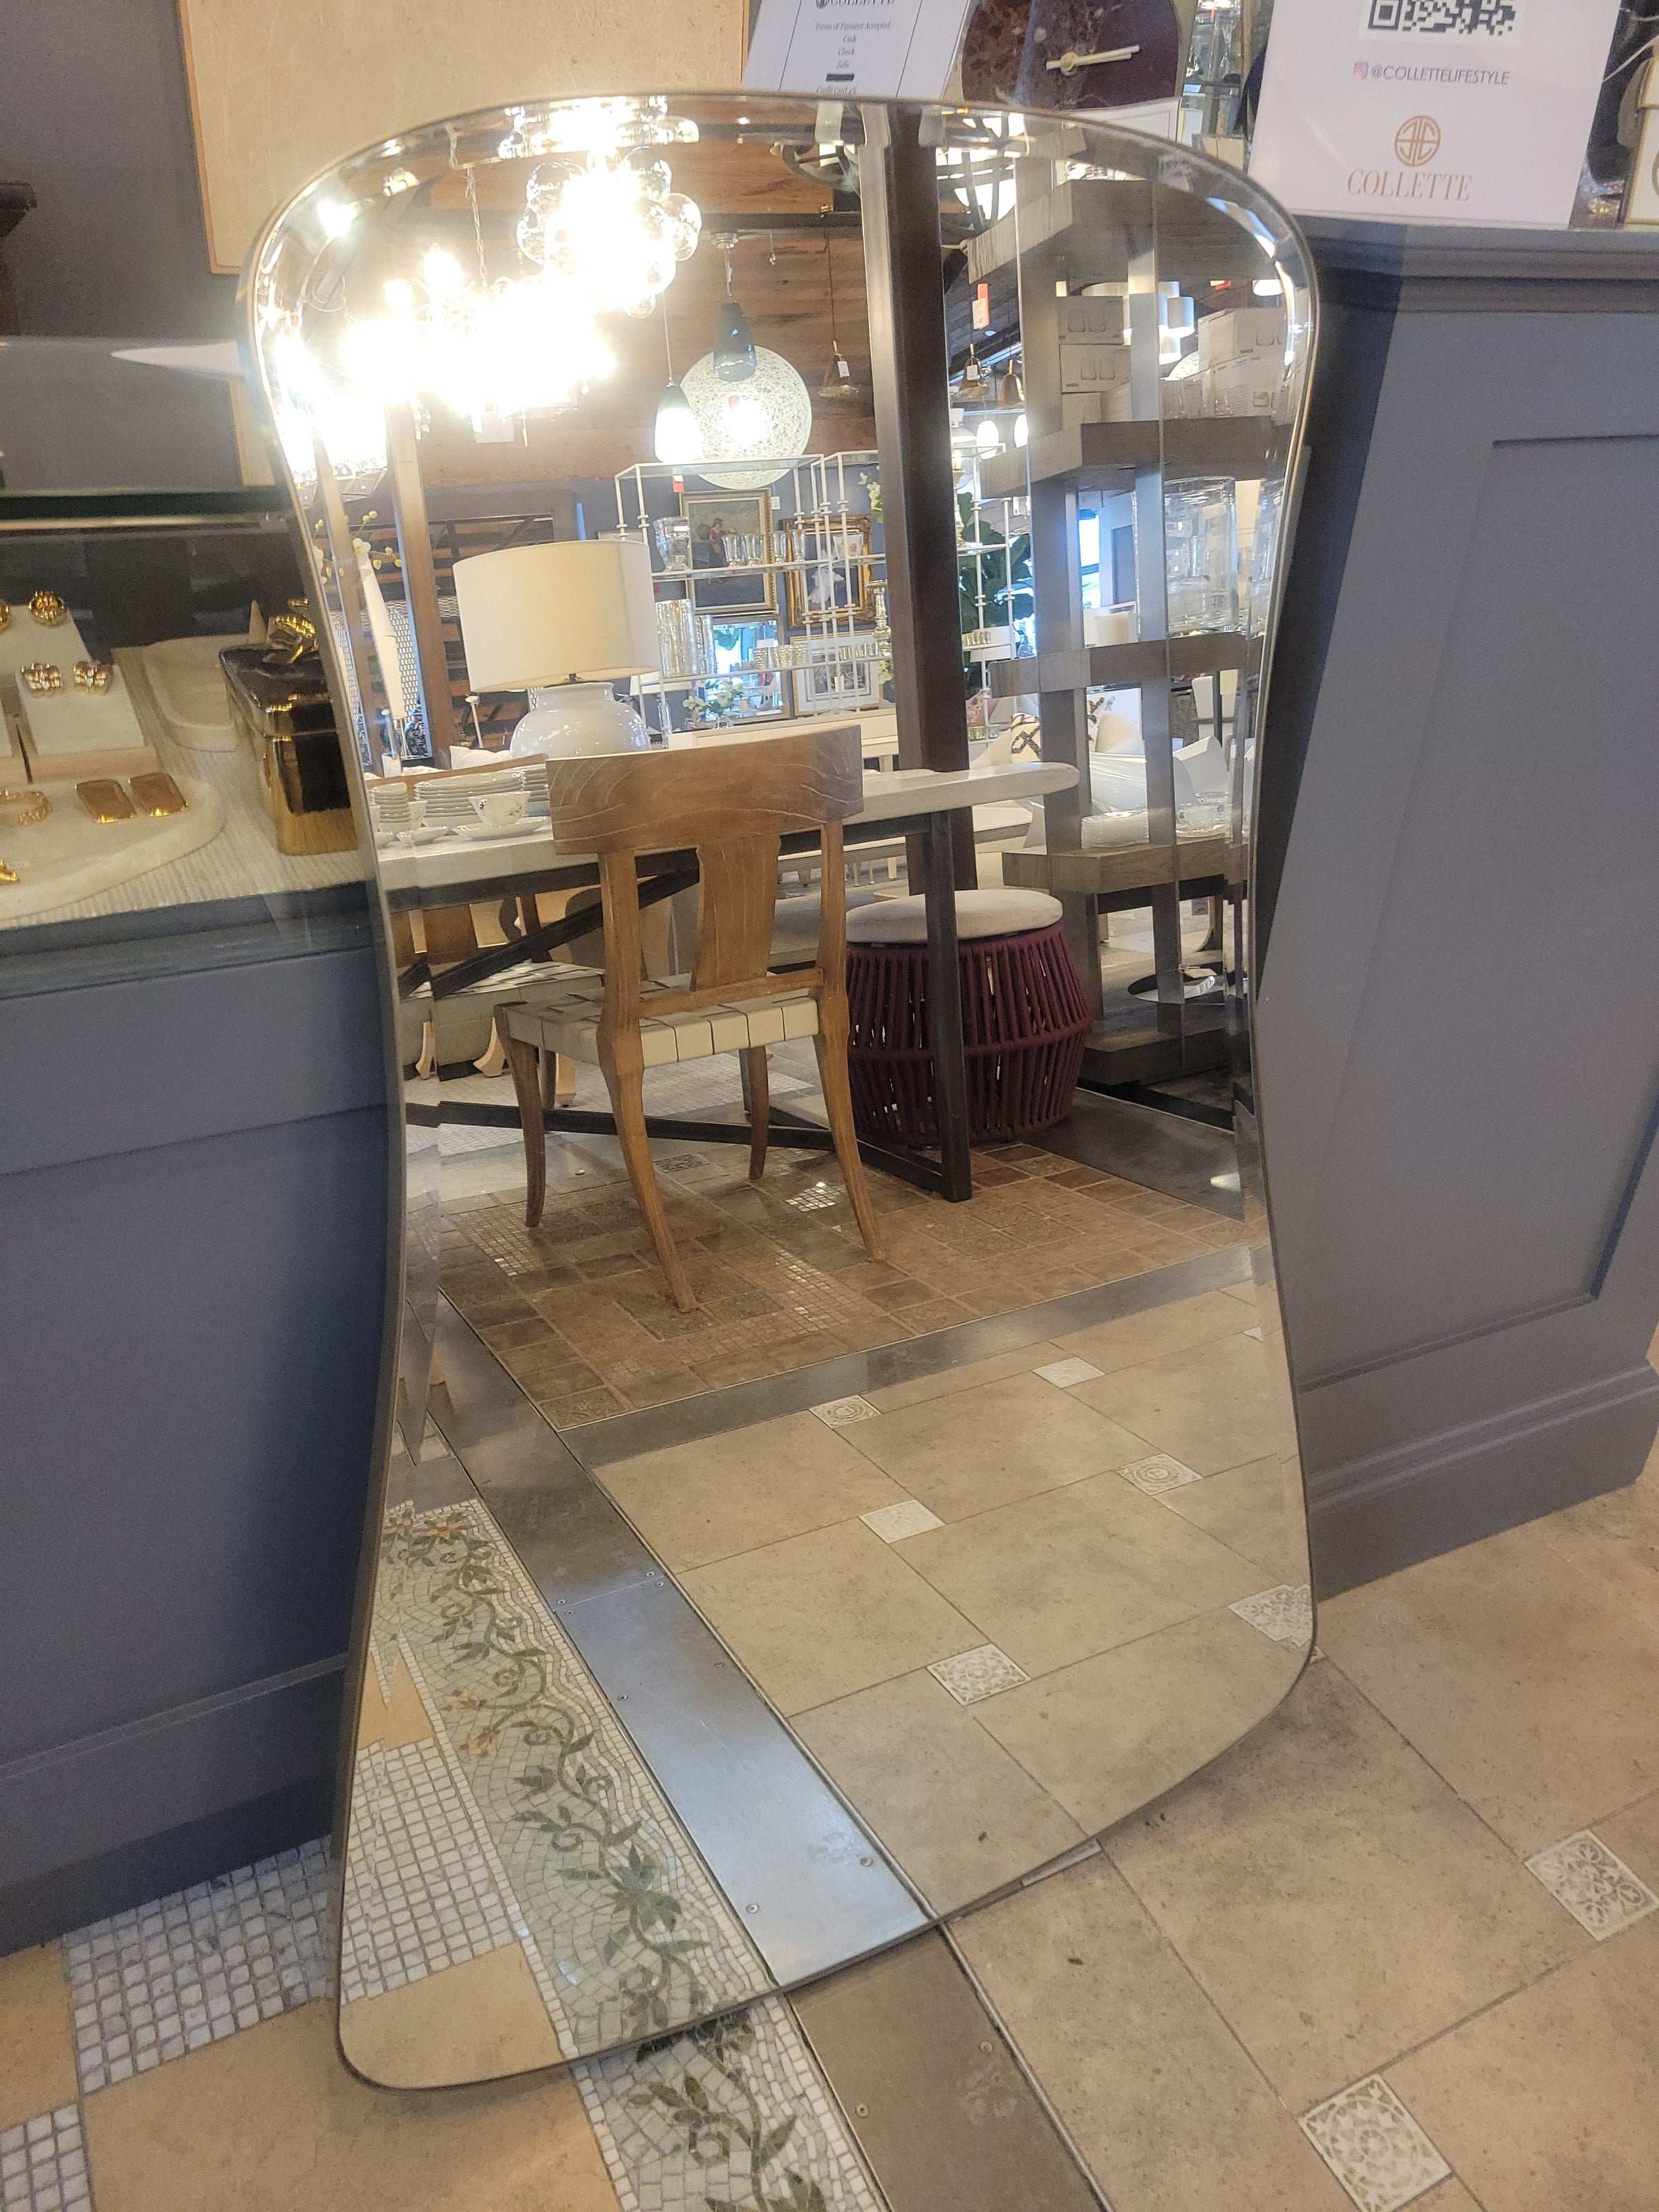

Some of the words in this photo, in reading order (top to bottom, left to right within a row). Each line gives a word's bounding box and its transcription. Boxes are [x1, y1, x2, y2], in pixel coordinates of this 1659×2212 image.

[840, 22, 864, 31] Payment
[865, 21, 891, 31] Accepted
[843, 35, 856, 43] Cash
[838, 47, 854, 55] Check
[1371, 66, 1510, 86] @COLLETTELIFESTYLE
[816, 86, 833, 94] Credit
[834, 86, 848, 95] Card
[1347, 169, 1473, 201] COLLETTE
